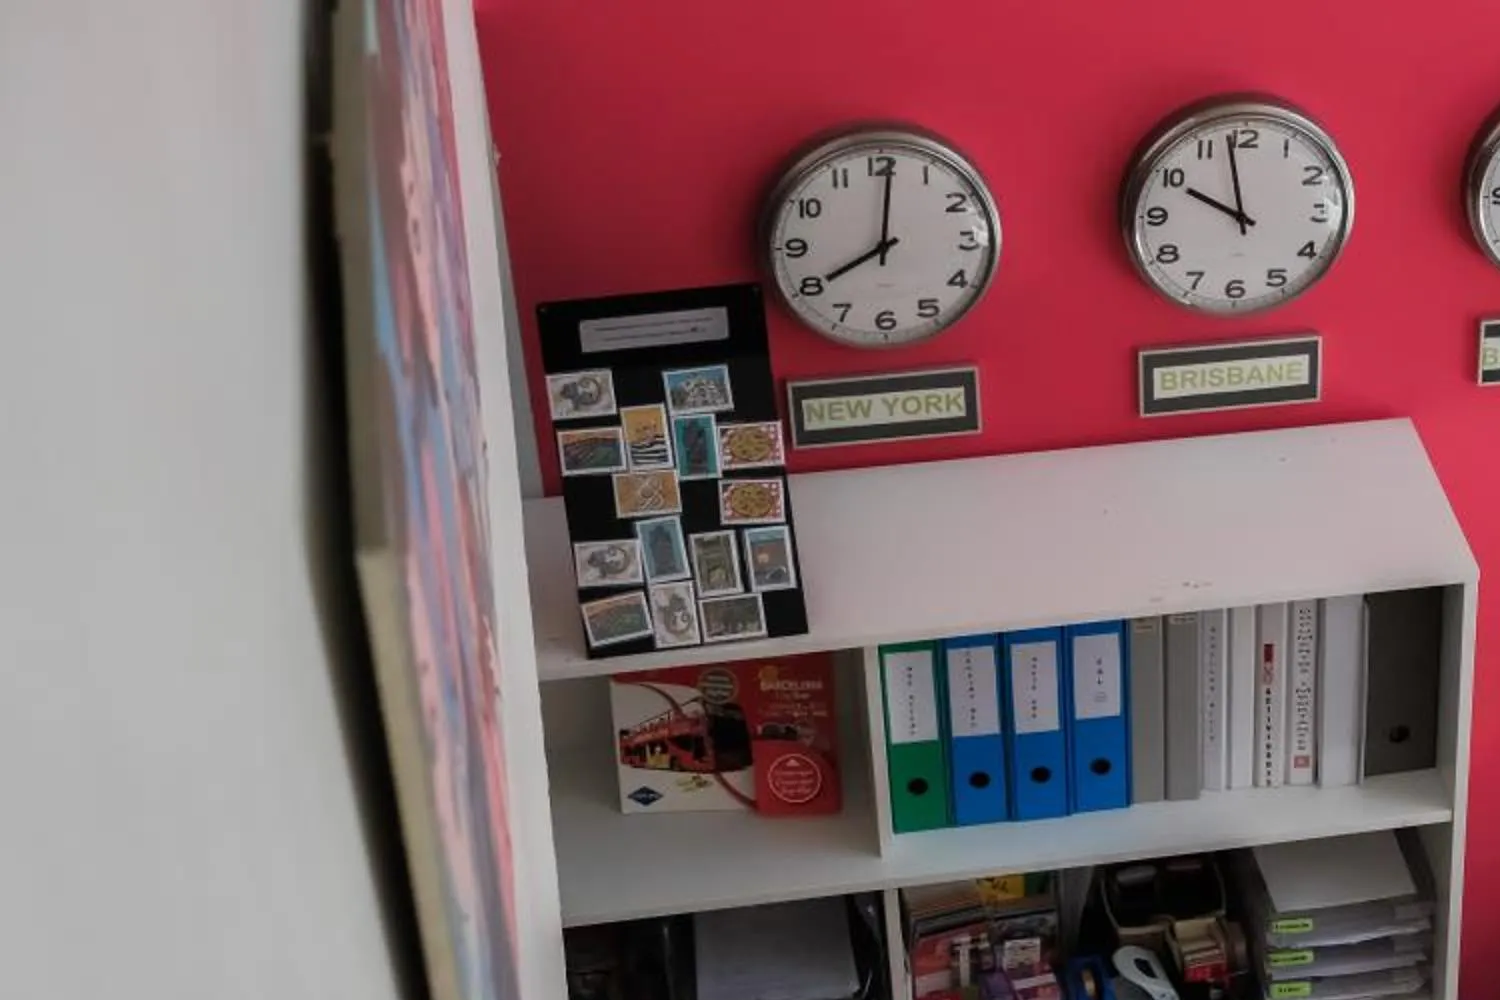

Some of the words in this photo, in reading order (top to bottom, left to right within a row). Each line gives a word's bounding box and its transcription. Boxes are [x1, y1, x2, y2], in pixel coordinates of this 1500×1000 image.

[1231, 129, 1258, 149] 12
[1197, 139, 1213, 160] 11
[867, 156, 897, 177] 12
[1302, 166, 1323, 186] 2
[832, 168, 849, 189] 11
[1163, 168, 1185, 187] 10
[799, 198, 822, 218] 10
[945, 193, 967, 212] 2
[1147, 207, 1168, 226] 9
[785, 238, 808, 257] 9
[1156, 244, 1180, 263] 8
[1296, 241, 1317, 259] 4
[799, 277, 824, 296] 8
[947, 269, 968, 288] 4
[1186, 271, 1204, 290] 7
[1266, 268, 1287, 287] 5
[1225, 280, 1245, 298] 6
[832, 303, 852, 323] 7
[917, 298, 940, 317] 5
[875, 311, 897, 330] 6
[1160, 361, 1303, 391] BRISBANE
[806, 399, 873, 424] NEW
[881, 392, 964, 416] YORK
